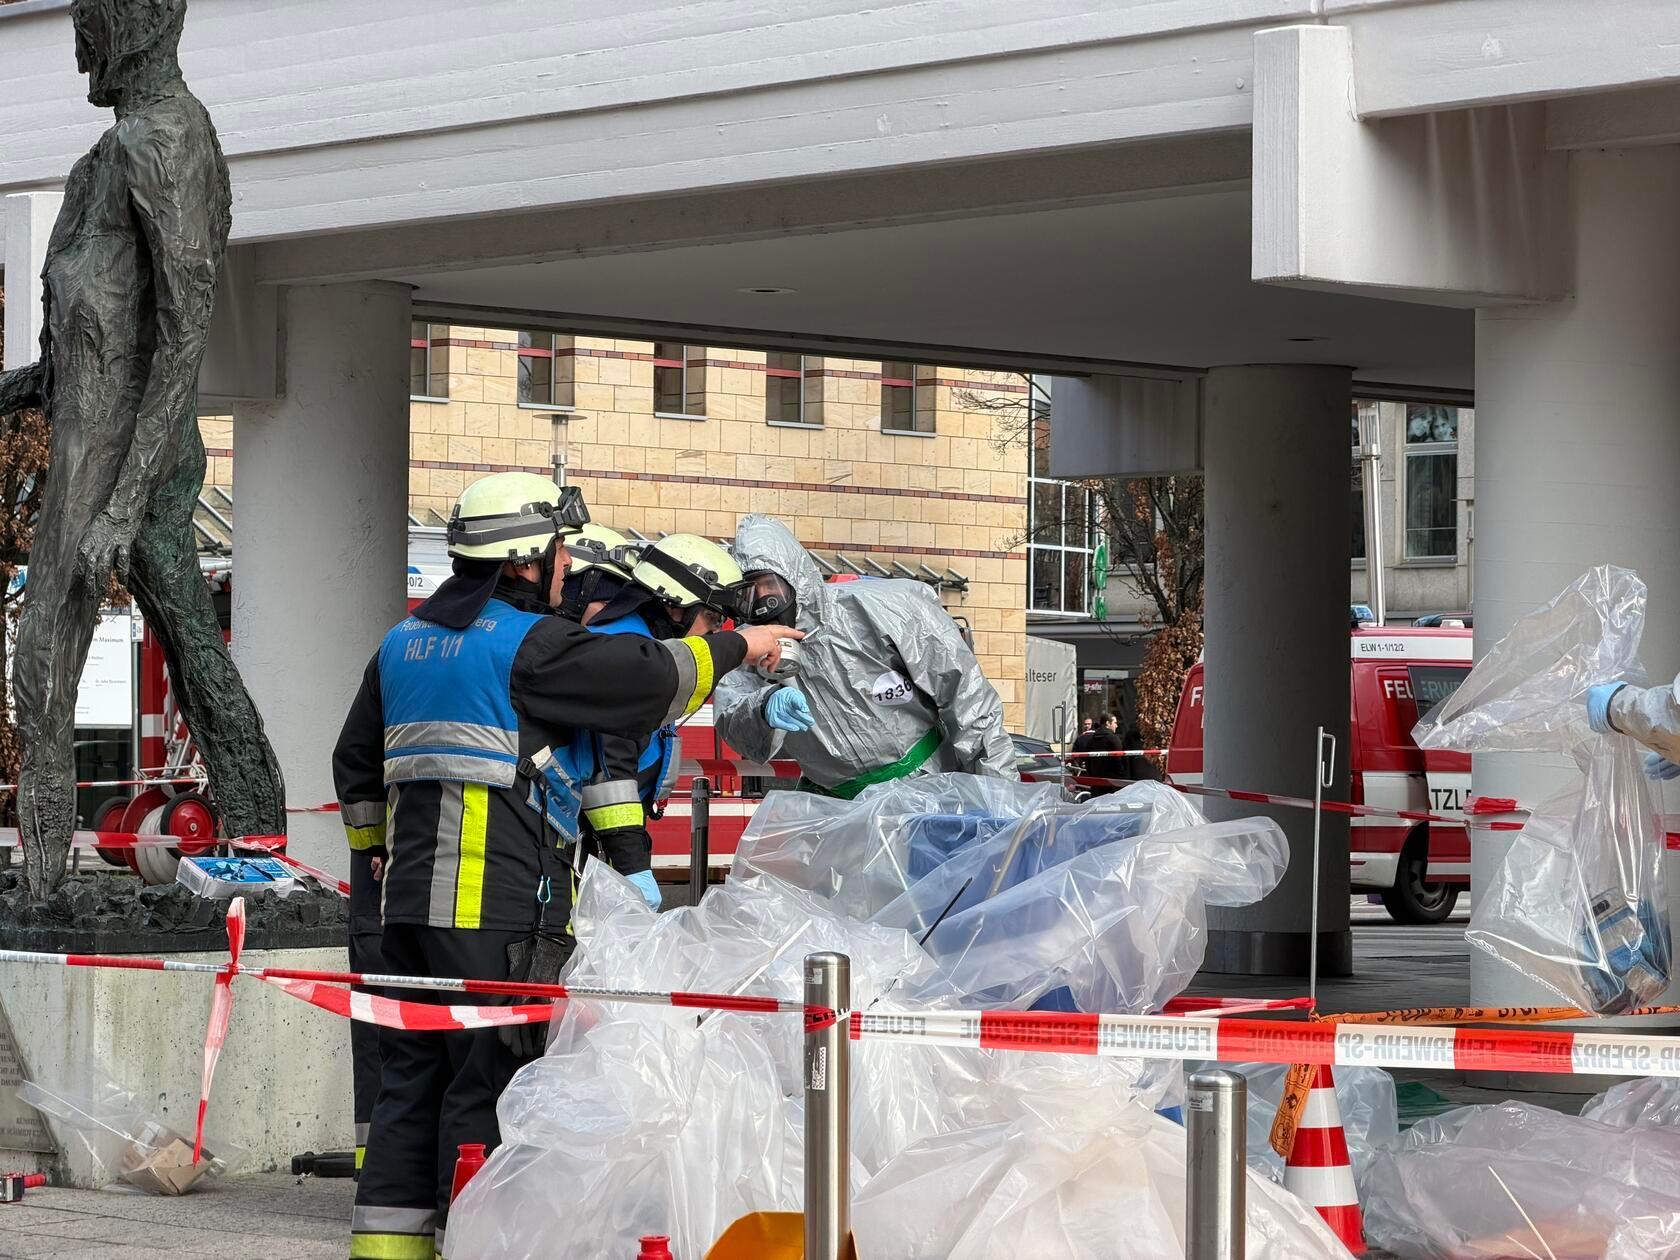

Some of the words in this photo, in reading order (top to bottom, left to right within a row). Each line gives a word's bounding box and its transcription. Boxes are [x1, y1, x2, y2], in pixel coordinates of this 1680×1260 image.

[529, 503, 535, 514] 1
[584, 539, 590, 547] 1
[696, 566, 702, 575] 1
[408, 576, 424, 588] 0/2
[404, 636, 438, 662] HLF
[440, 634, 465, 659] 1/1
[1360, 643, 1377, 652] ELW
[1025, 668, 1057, 682] alteser
[1429, 788, 1472, 810] TZL
